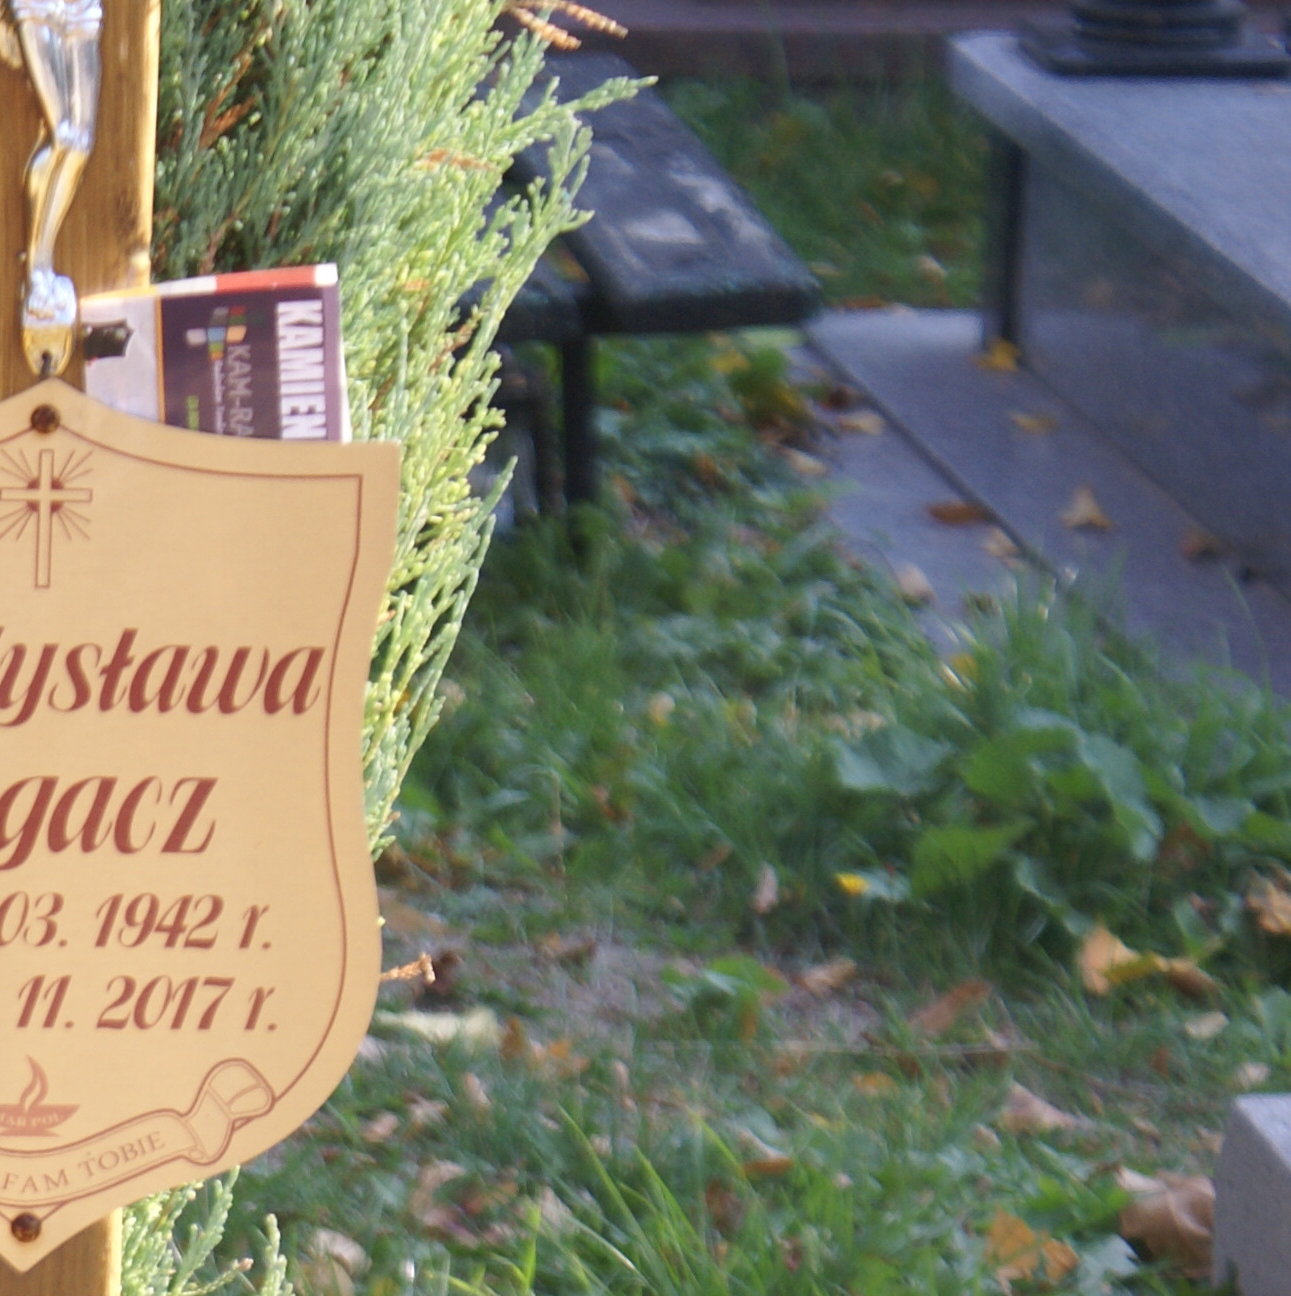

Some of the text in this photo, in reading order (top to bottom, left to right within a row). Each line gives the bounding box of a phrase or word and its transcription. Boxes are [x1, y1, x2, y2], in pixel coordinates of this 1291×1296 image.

[94, 893, 225, 951] 1942
[239, 901, 272, 950] r.
[16, 974, 74, 1029] 11.
[95, 975, 235, 1031] 2017
[243, 984, 277, 1032] r.
[77, 1130, 166, 1178] TOBIE
